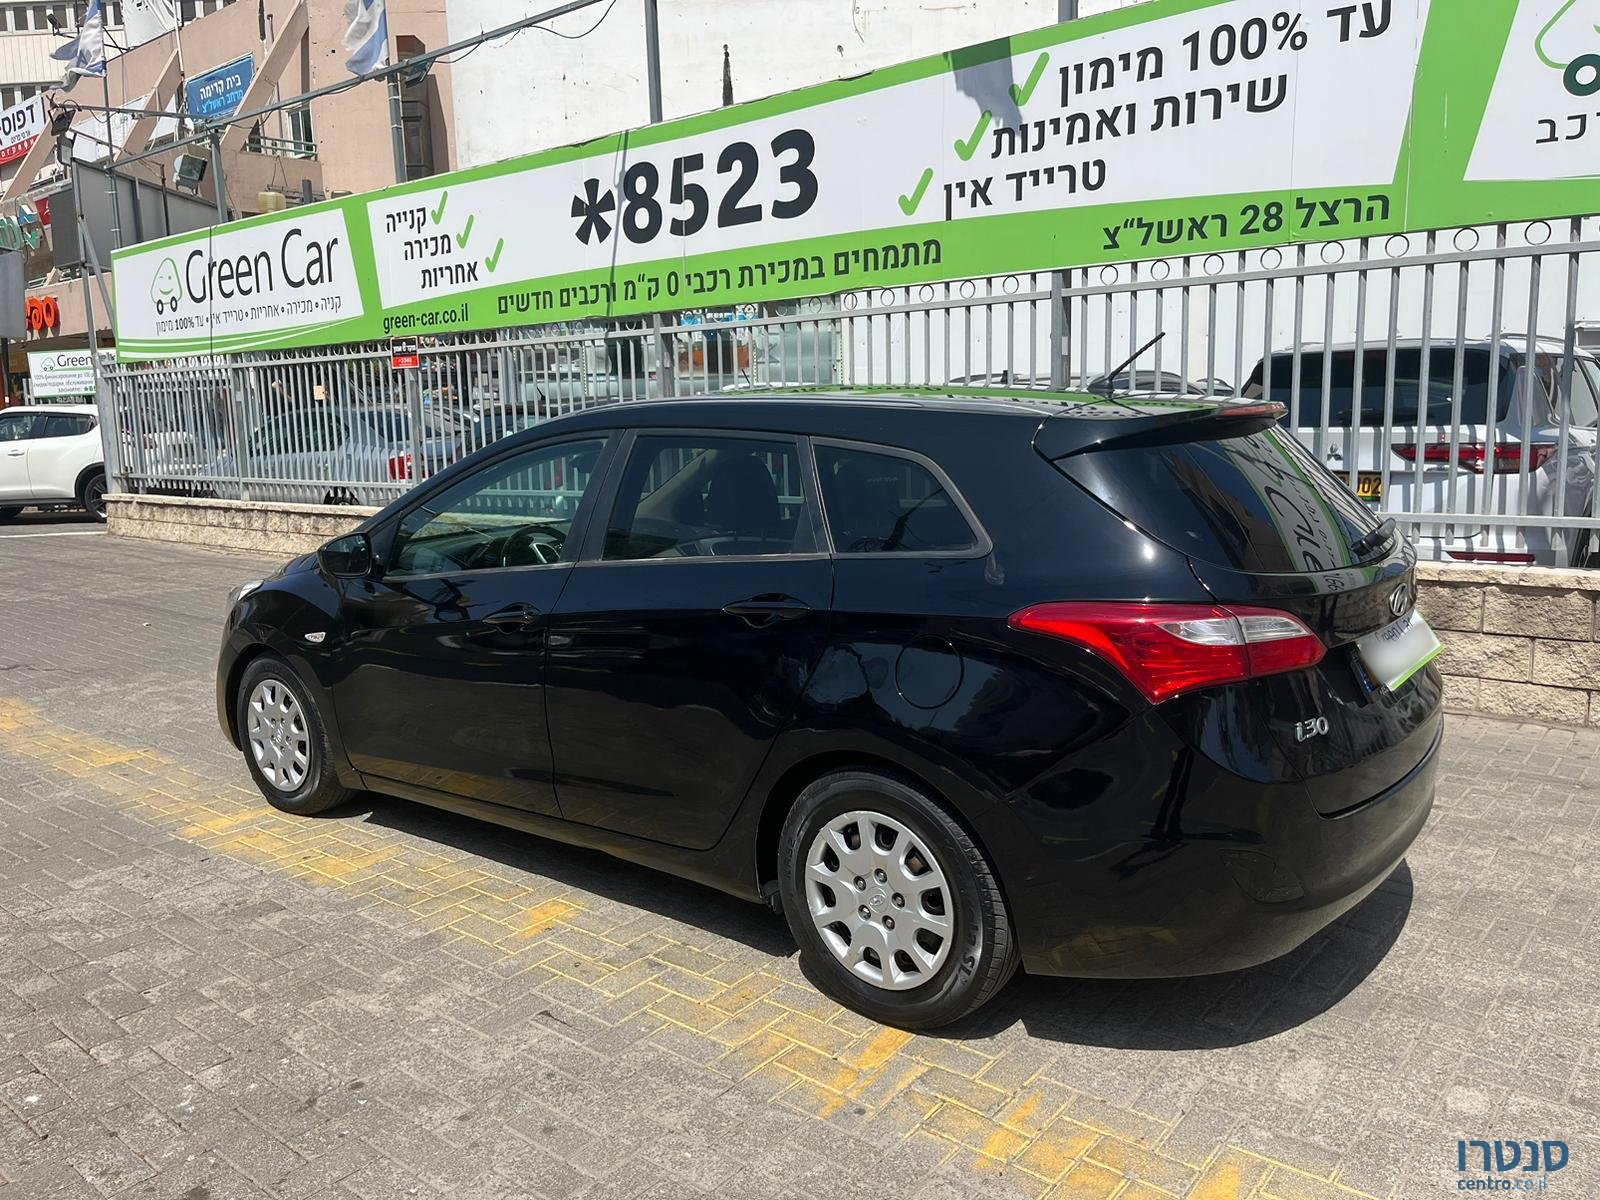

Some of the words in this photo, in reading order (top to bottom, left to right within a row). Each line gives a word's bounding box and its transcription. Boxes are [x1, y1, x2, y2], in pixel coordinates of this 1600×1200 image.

[1326, 0, 1392, 43] עד
[1182, 11, 1308, 71] 100%
[200, 80, 224, 100] קדימה
[226, 74, 242, 90] בית
[1059, 45, 1164, 107] מימון
[1151, 73, 1288, 131] שירות
[2, 104, 36, 136] דפוס
[991, 101, 1136, 160] ואמינות
[1535, 111, 1600, 144] כב
[1005, 159, 1106, 202] טרייד
[944, 176, 993, 221] אין
[1295, 194, 1391, 229] הרצל
[386, 207, 427, 234] קנייה
[1239, 202, 1283, 235] 28
[404, 233, 452, 260] מכירה
[834, 239, 942, 275] מתמחים
[185, 249, 273, 303] Green
[281, 228, 339, 288] Car
[421, 261, 478, 289] אחריות
[738, 254, 825, 288] במכירת
[560, 281, 617, 308] ורכבים
[686, 270, 730, 295] רכבי
[223, 309, 244, 322] טרייד
[250, 304, 279, 320] אחריות
[286, 299, 313, 316] מכירה
[320, 295, 342, 314] קניה
[498, 290, 553, 315] חדשים
[175, 316, 195, 331] 100%
[383, 303, 469, 334] green-car.co.il
[57, 354, 93, 367] Green
[1293, 716, 1330, 743] i30
